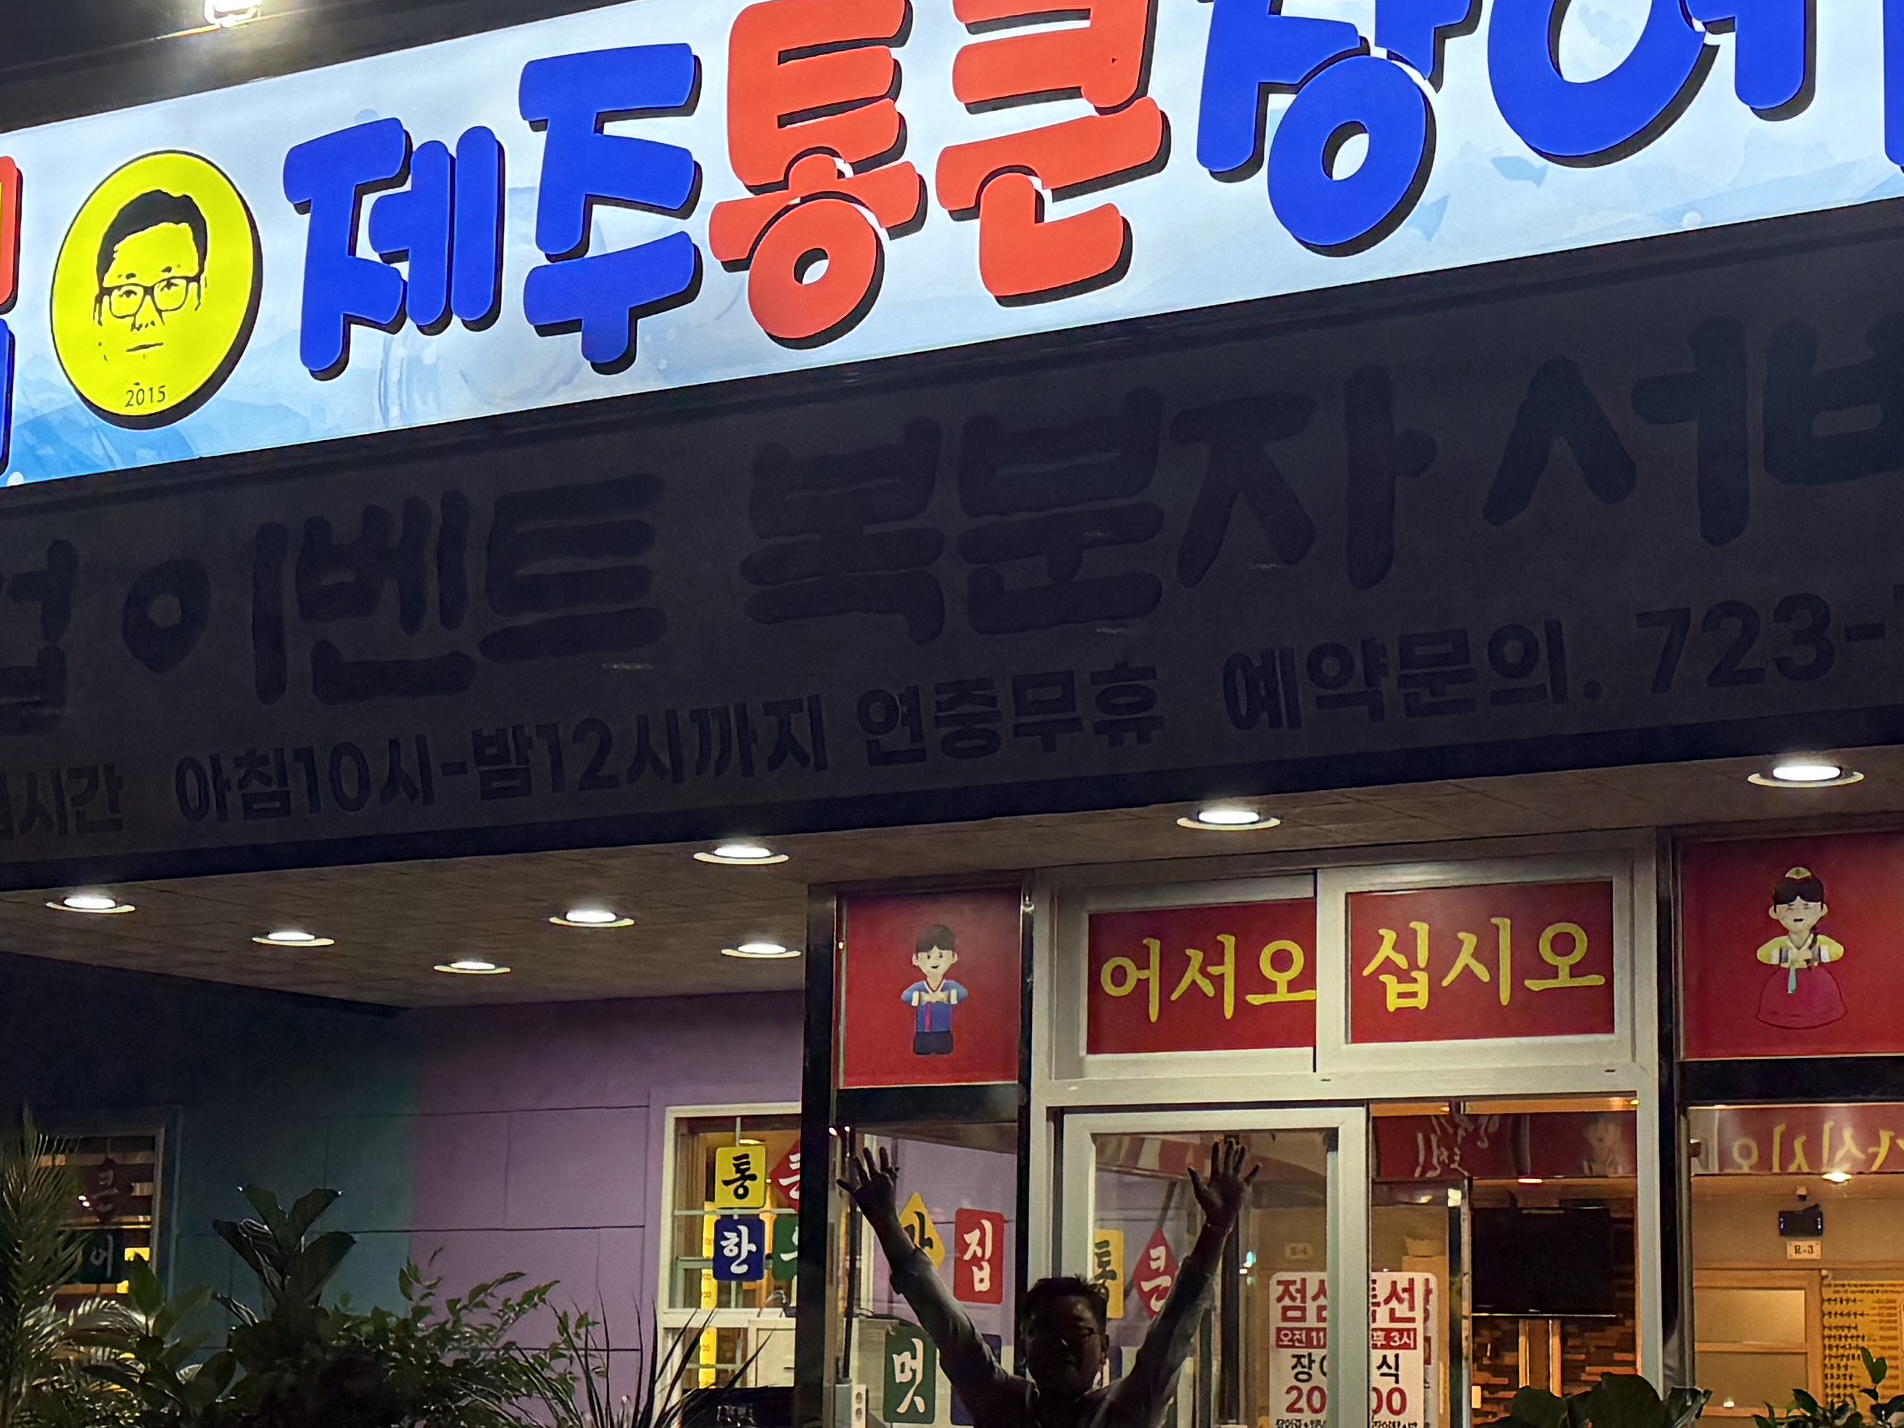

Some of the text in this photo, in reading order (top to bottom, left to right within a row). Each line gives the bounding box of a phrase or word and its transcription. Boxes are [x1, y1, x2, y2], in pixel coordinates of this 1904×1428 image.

[124, 383, 167, 409] 2015
[122, 472, 669, 706] 이벤트
[740, 369, 1437, 646] 복분자
[859, 662, 1167, 767] 연중무휴
